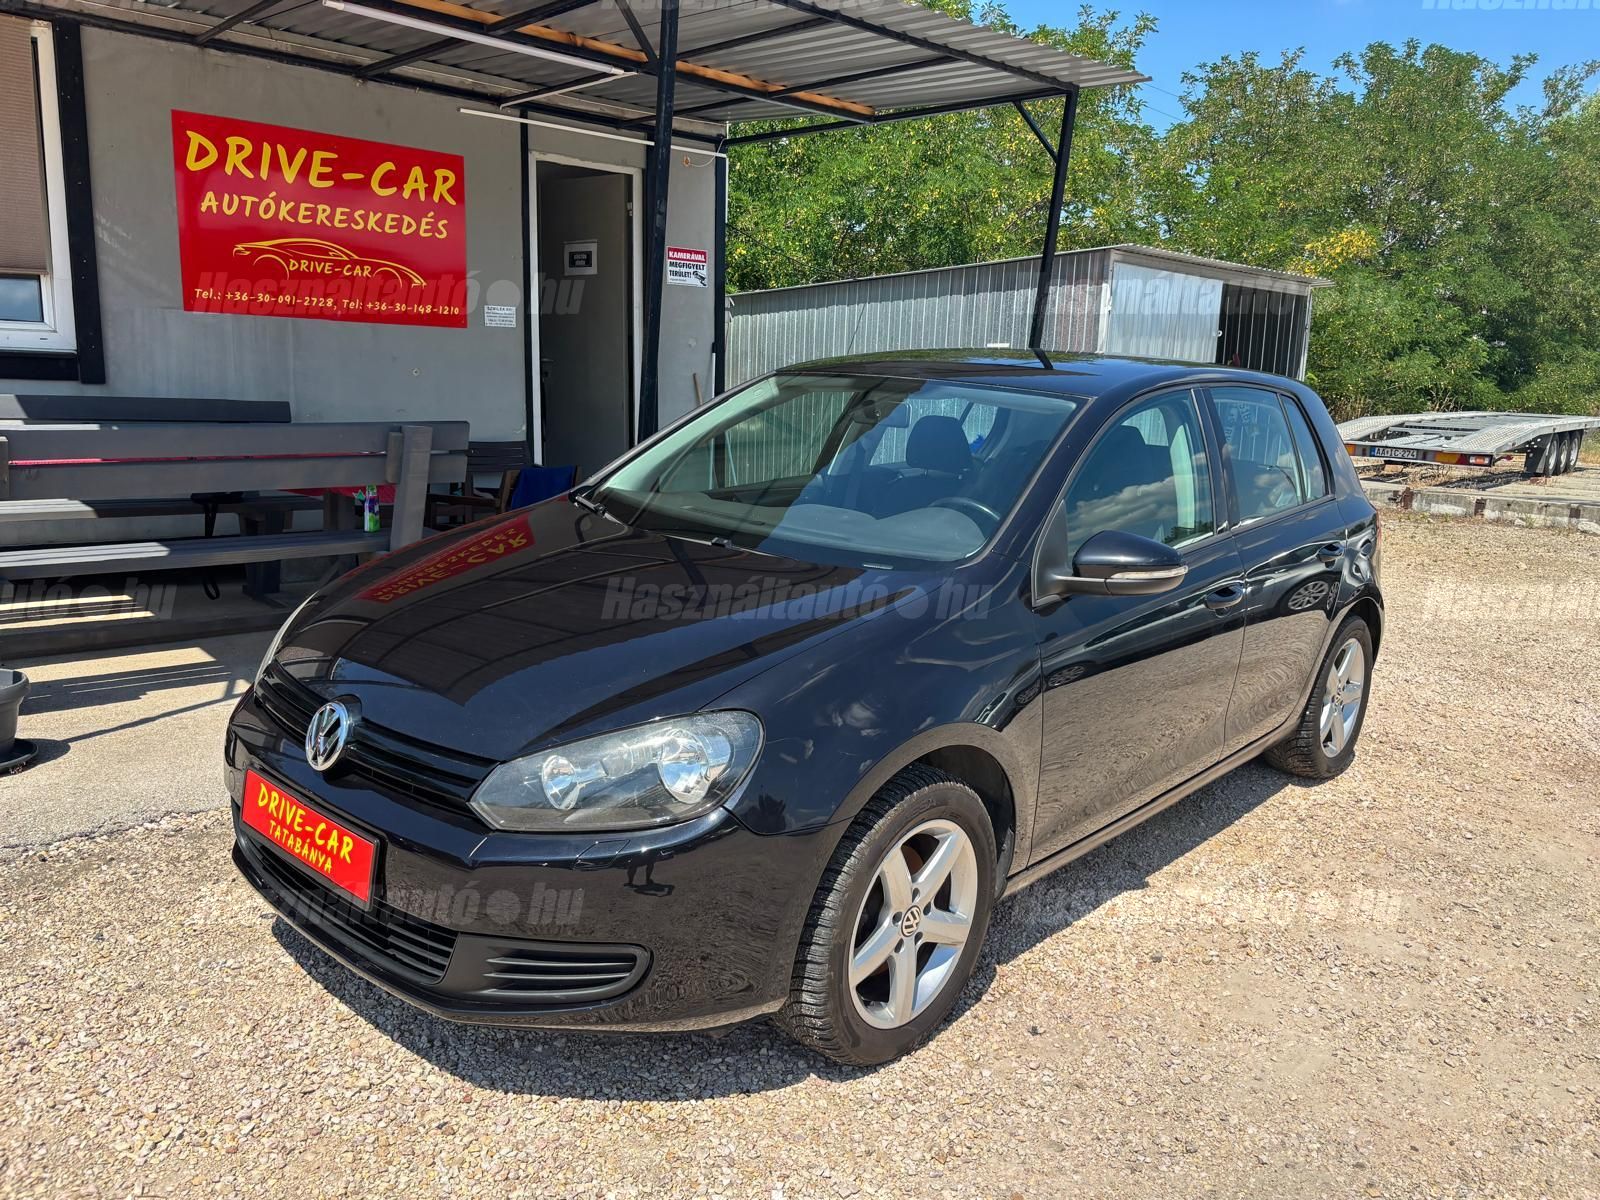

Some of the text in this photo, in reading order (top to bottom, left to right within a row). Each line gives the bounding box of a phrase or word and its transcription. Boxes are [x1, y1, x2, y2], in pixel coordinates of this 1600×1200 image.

[185, 130, 457, 205] DRIVE-CAR
[200, 191, 449, 239] AUTÓKERESKEDÉS
[289, 259, 372, 277] DRIVE-CAR
[669, 251, 706, 261] KAMERÁVAL
[669, 261, 706, 270] MEGFIGYELT
[366, 302, 460, 316] +36-30-148-1210
[257, 782, 354, 864] DRIVE-CAR
[269, 820, 333, 874] TATABÁNYA
